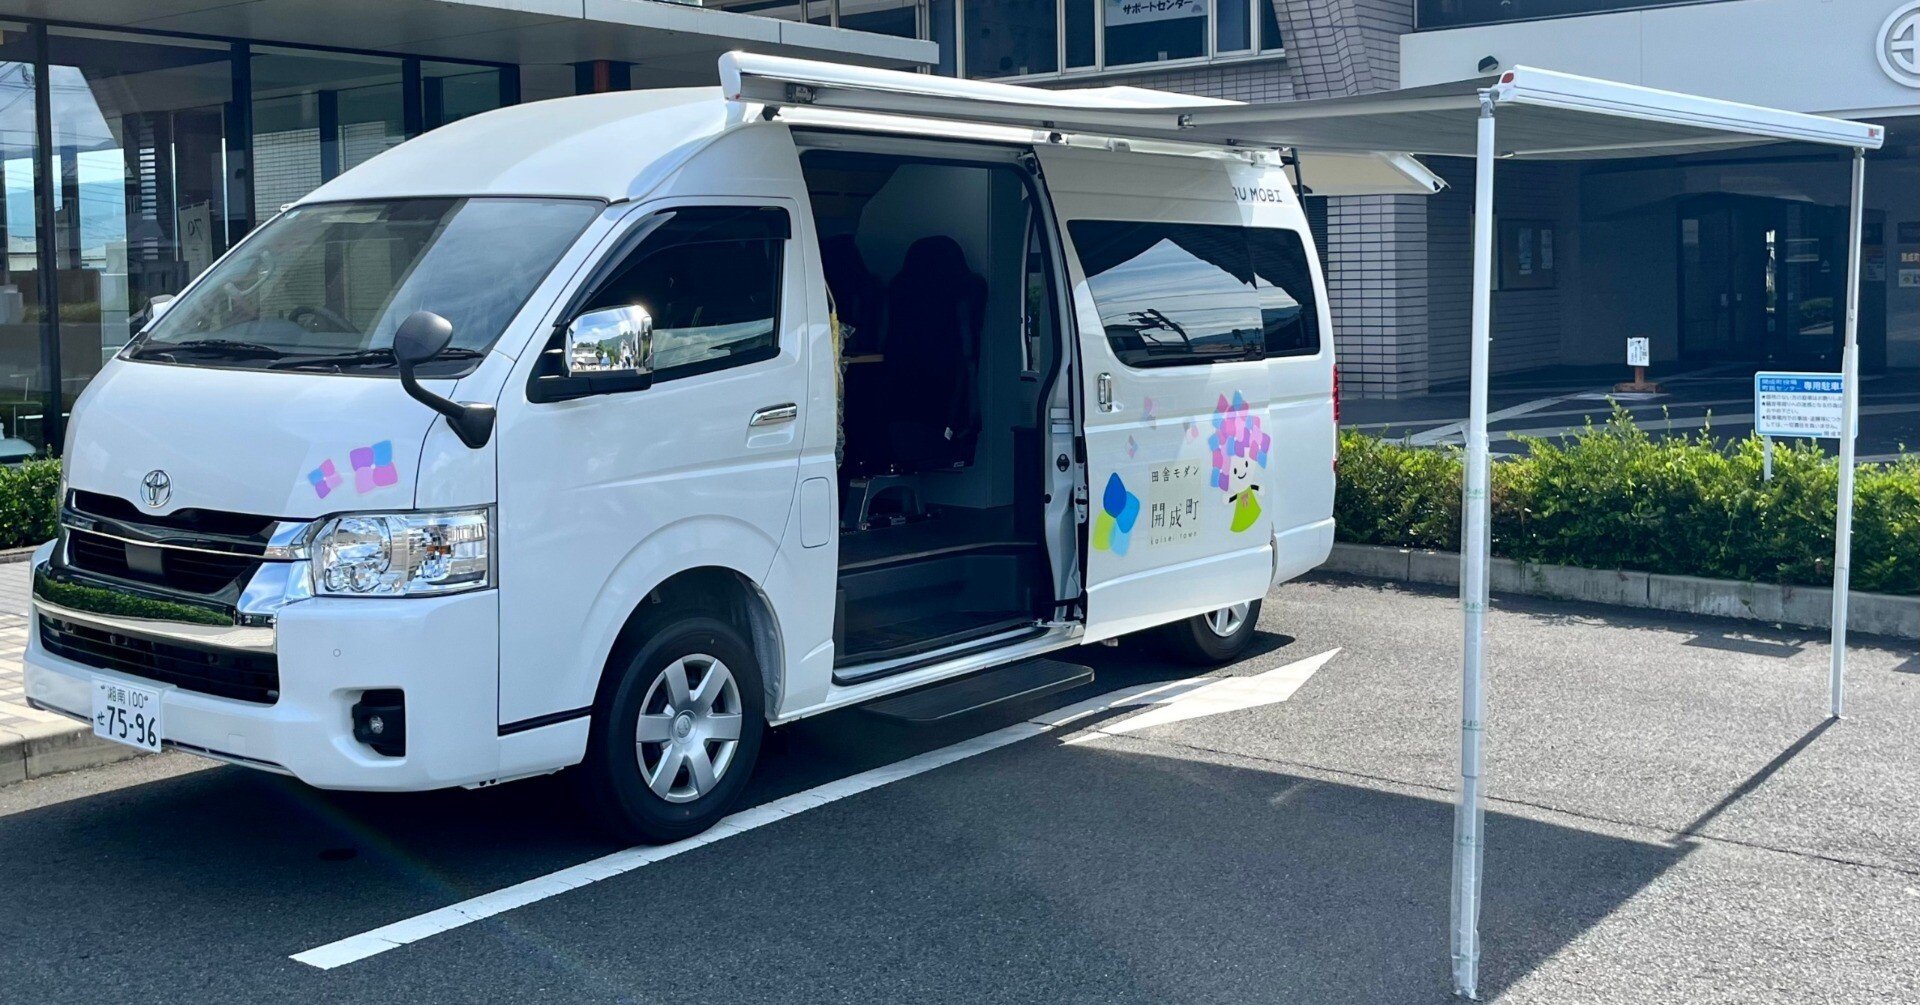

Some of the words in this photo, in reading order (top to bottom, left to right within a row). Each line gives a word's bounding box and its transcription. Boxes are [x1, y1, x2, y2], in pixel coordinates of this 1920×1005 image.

[1123, 0, 1193, 14] サポートセンター
[1250, 187, 1282, 202] MOBI
[1151, 466, 1199, 483] 田舎モダン
[1151, 498, 1199, 528] 開成町
[107, 705, 157, 747] 75-96
